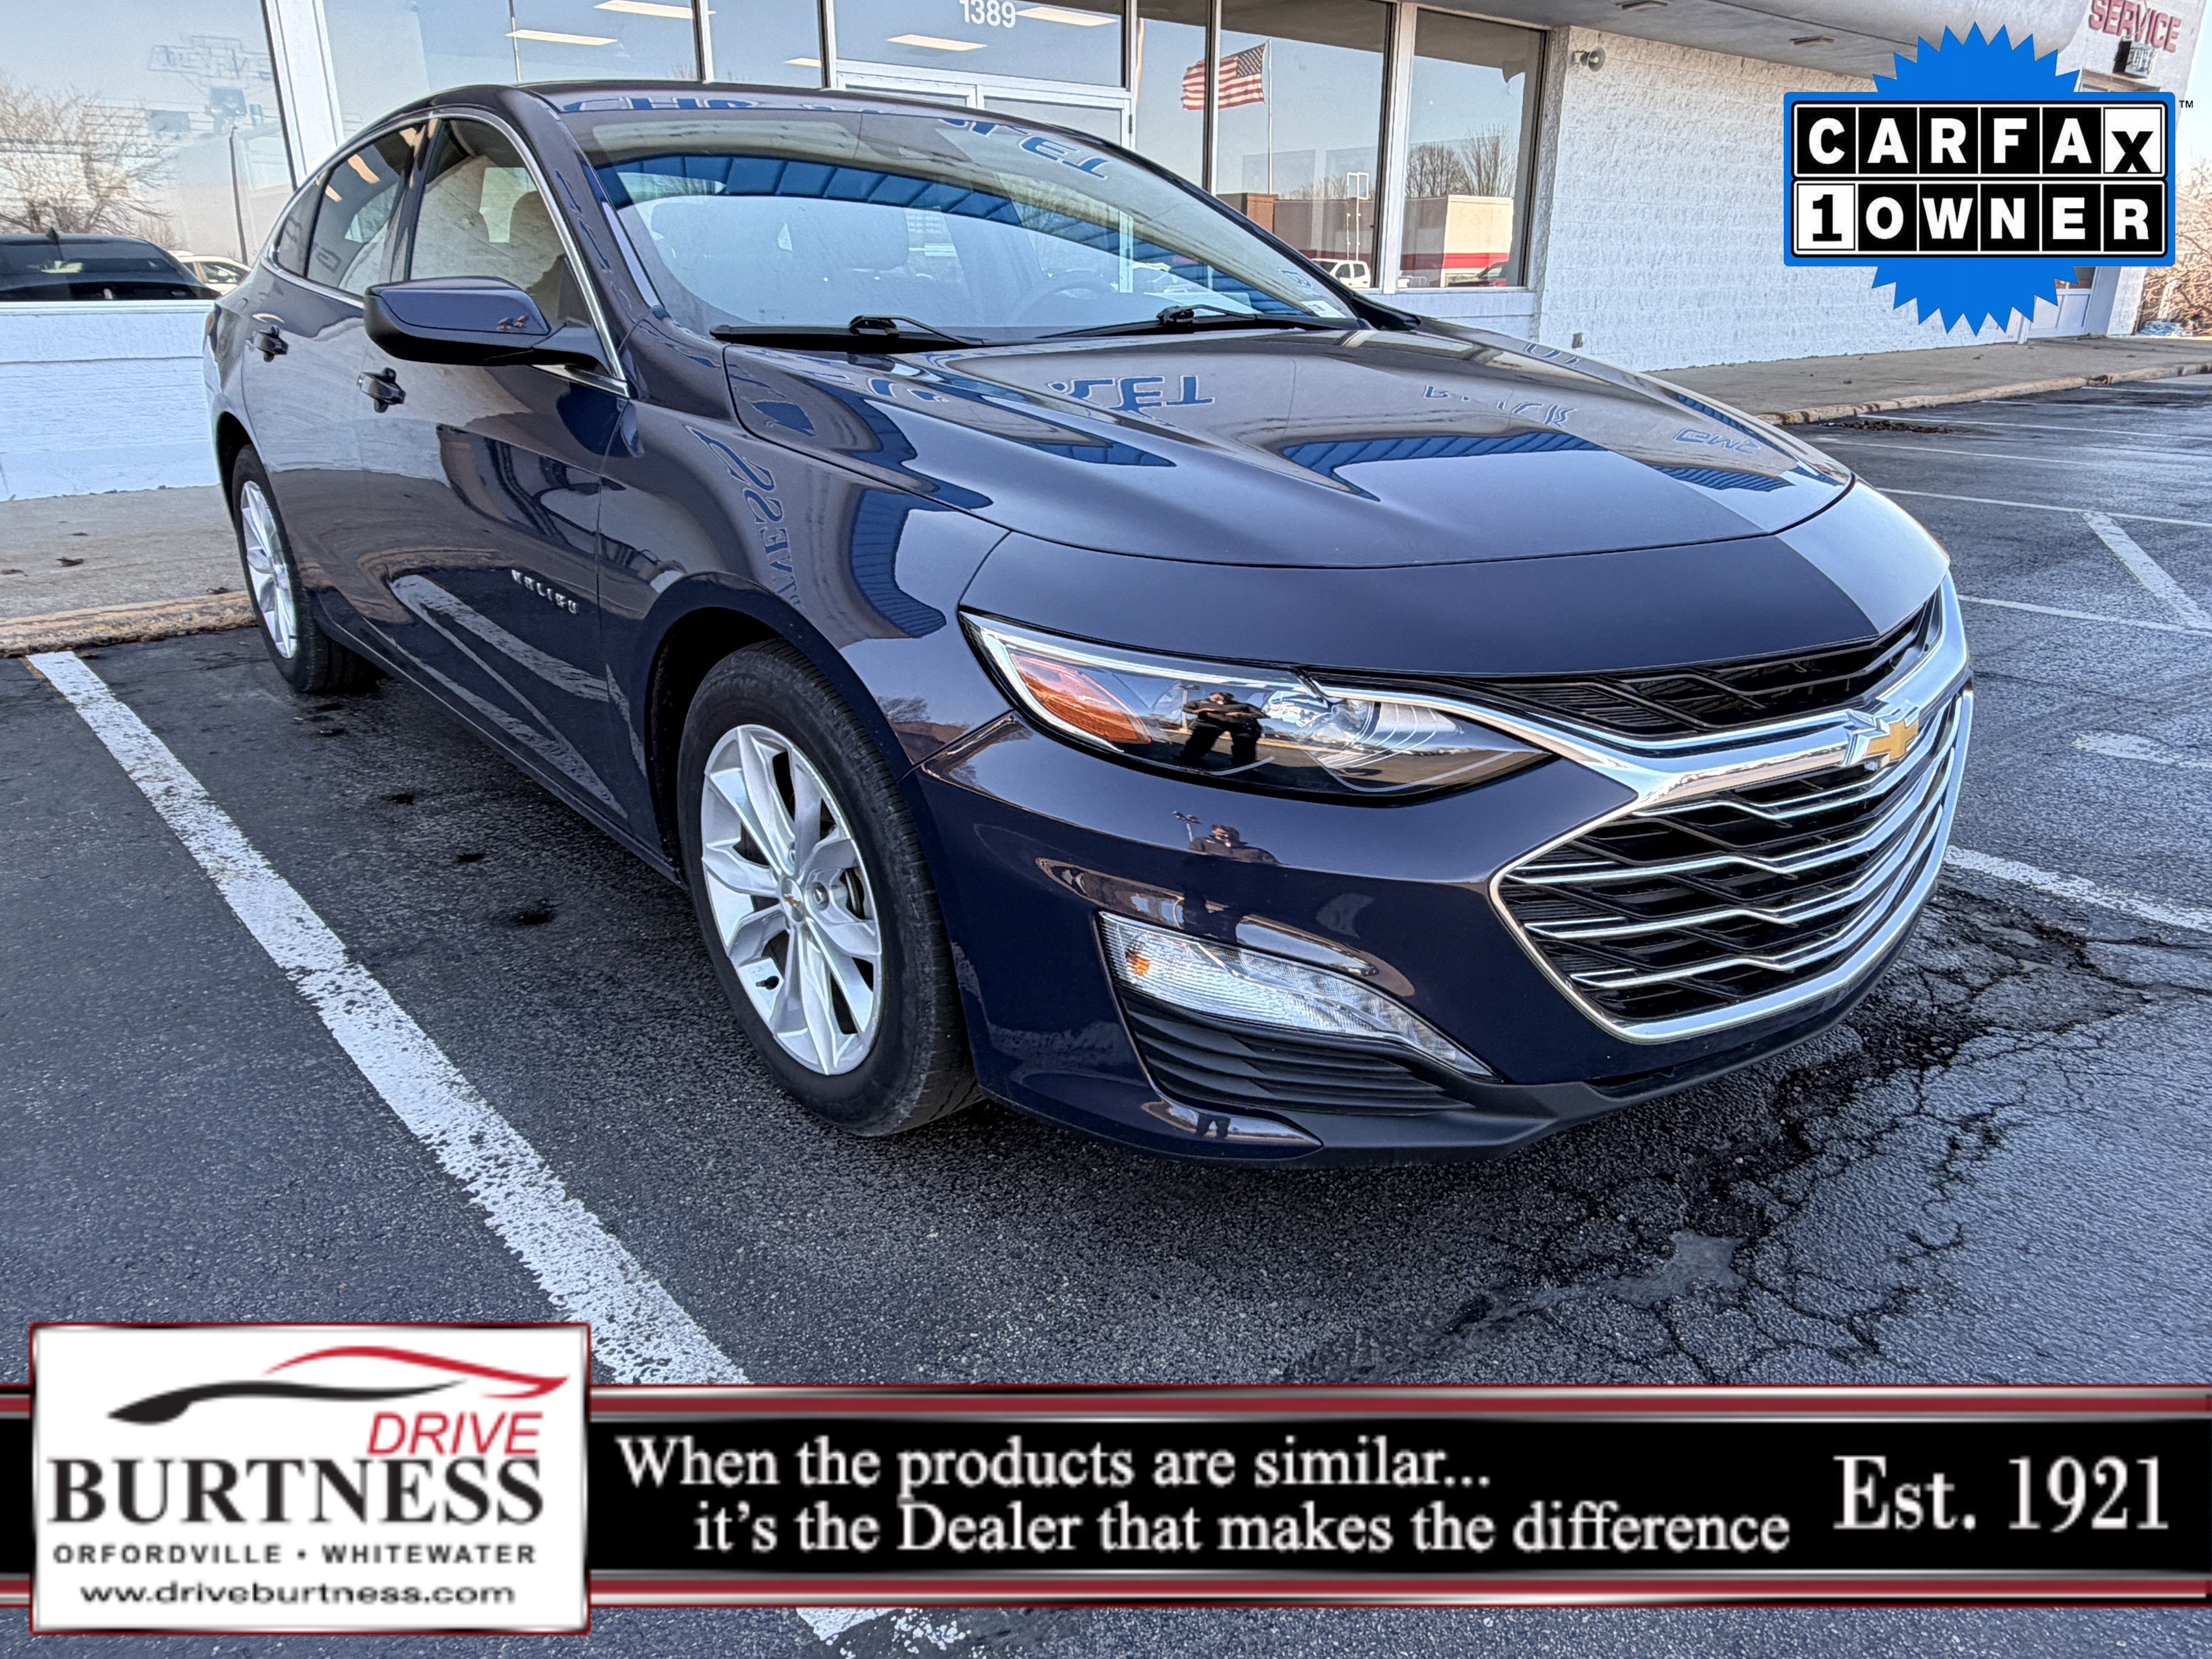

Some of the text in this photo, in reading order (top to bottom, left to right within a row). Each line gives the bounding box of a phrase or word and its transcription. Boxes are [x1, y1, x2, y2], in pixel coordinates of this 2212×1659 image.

[959, 0, 1016, 28] 1389
[2088, 0, 2182, 53] SERVICE
[511, 569, 579, 614] MALIBU
